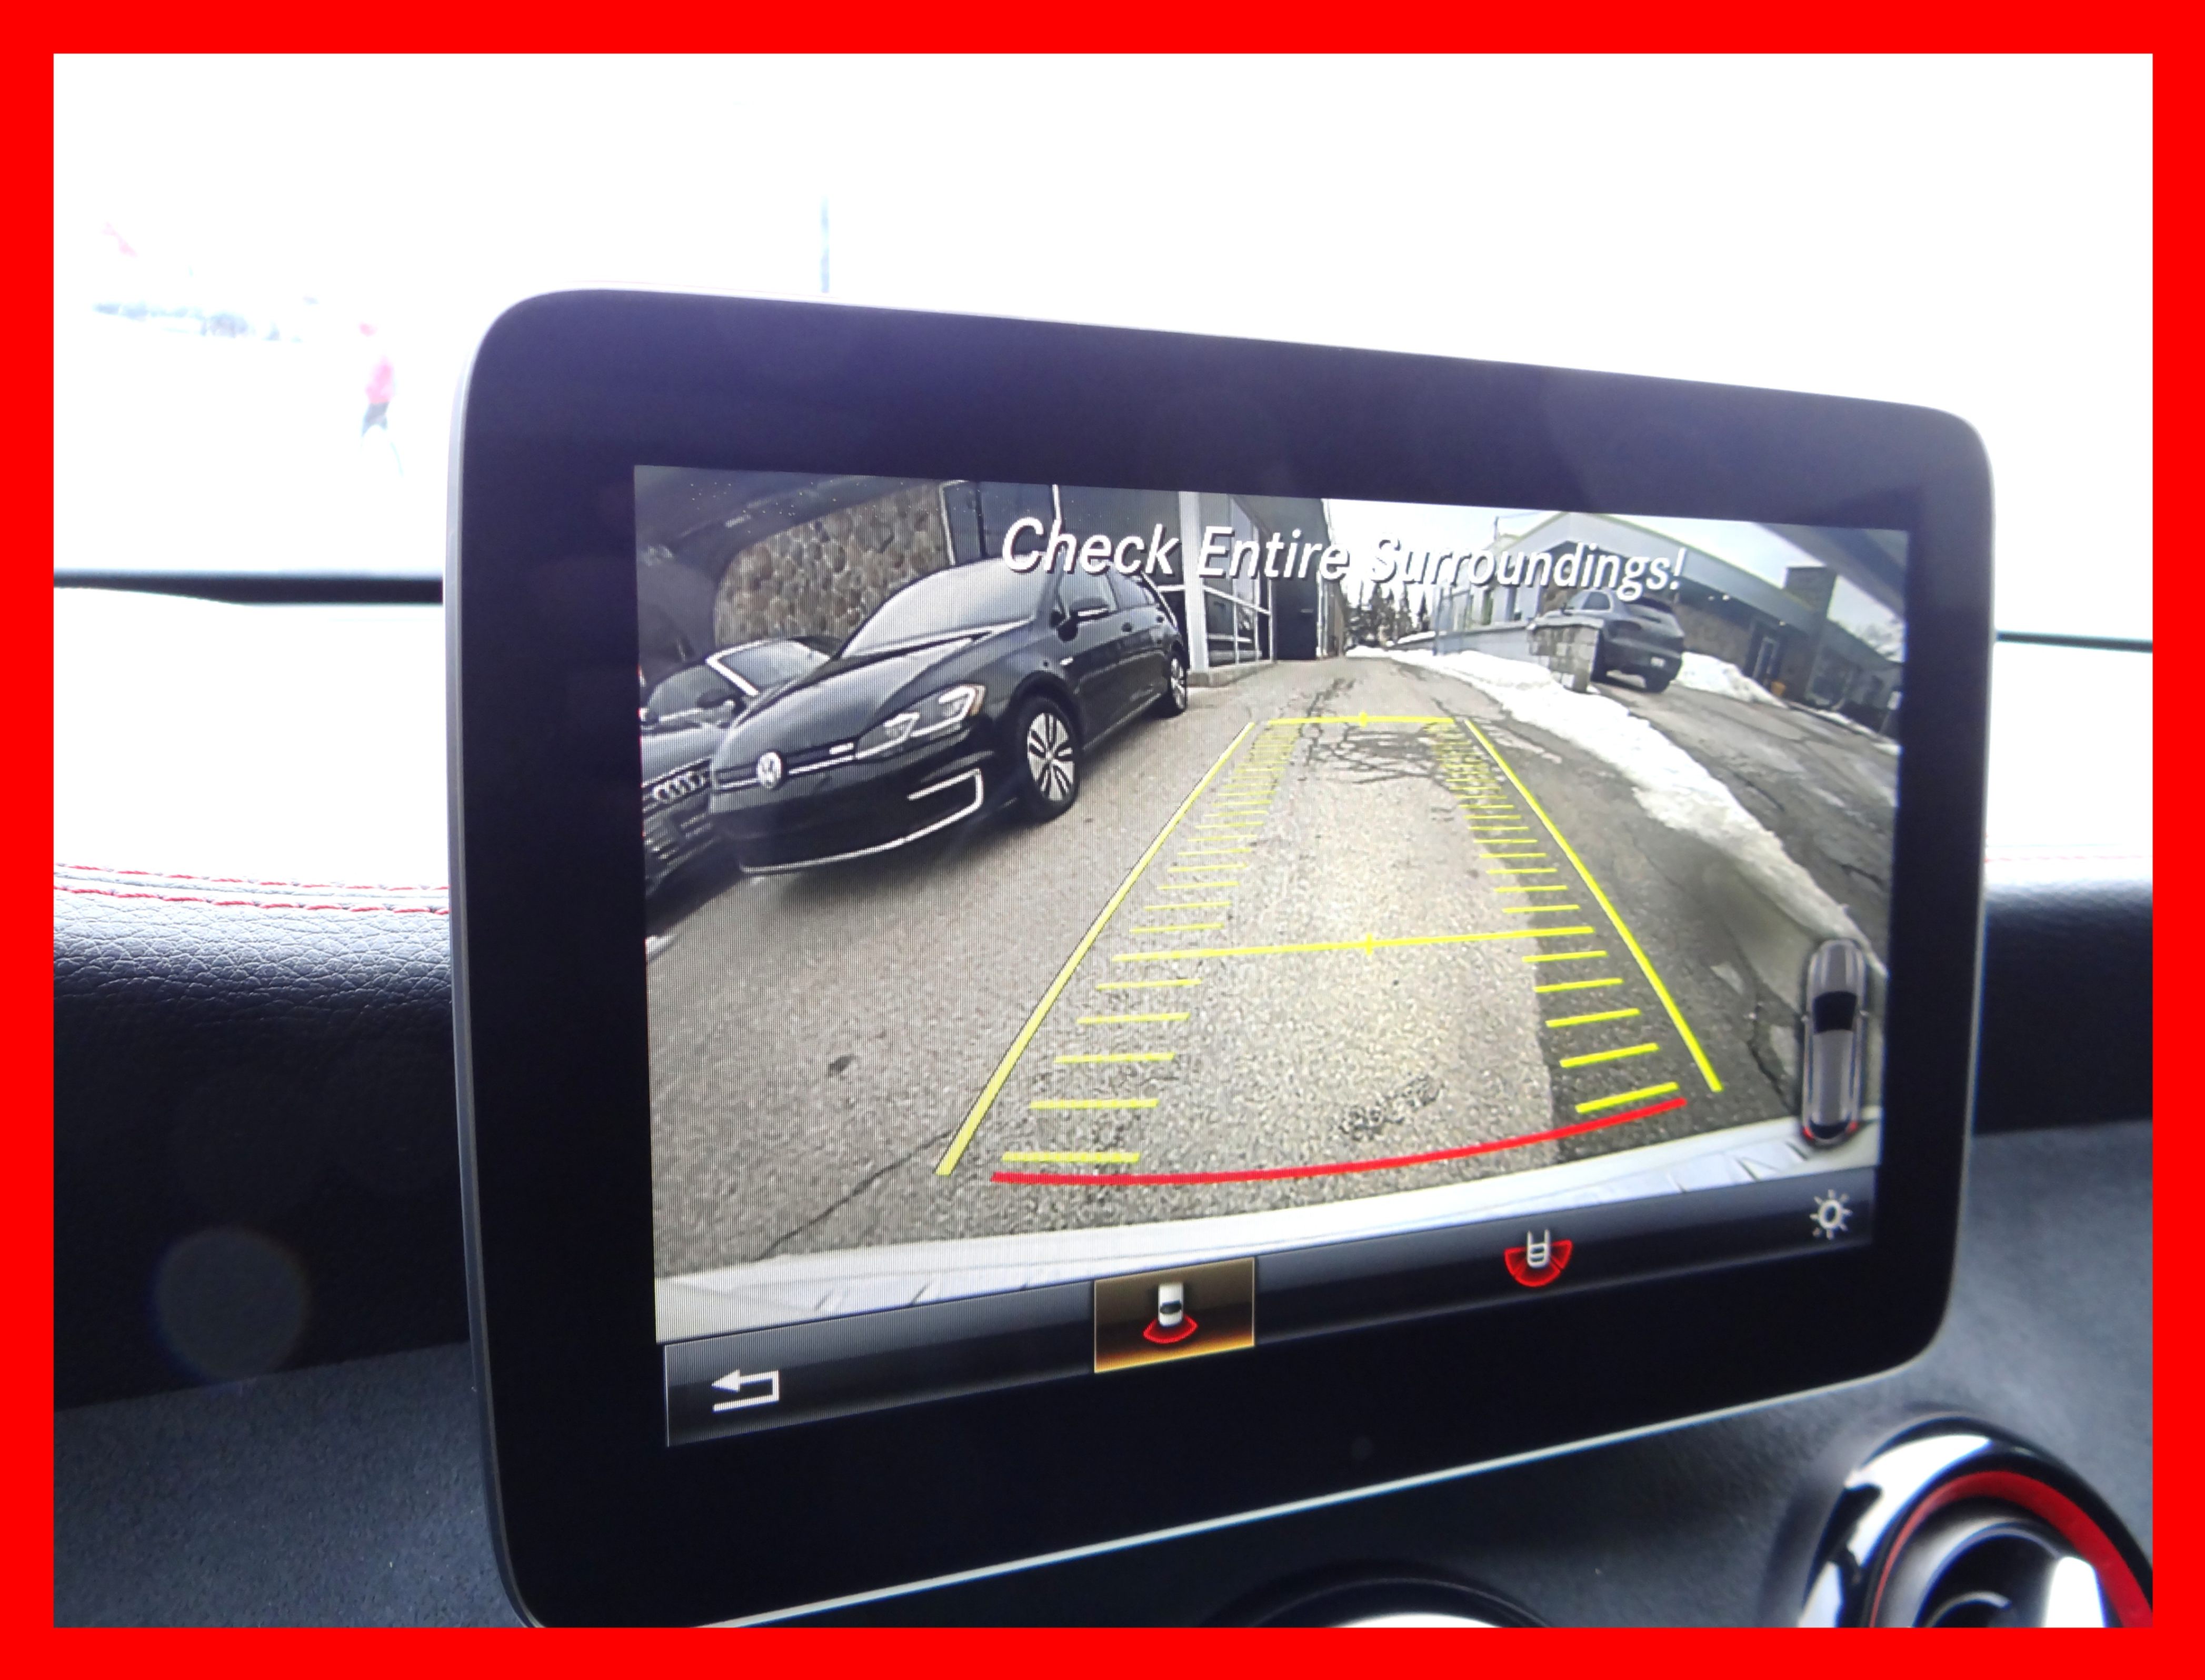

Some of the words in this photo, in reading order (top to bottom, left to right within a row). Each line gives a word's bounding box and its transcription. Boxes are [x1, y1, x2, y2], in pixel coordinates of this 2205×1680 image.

[1002, 517, 1180, 575] Check
[1199, 525, 1350, 580] Entire
[1369, 533, 1687, 602] Surroundings!
